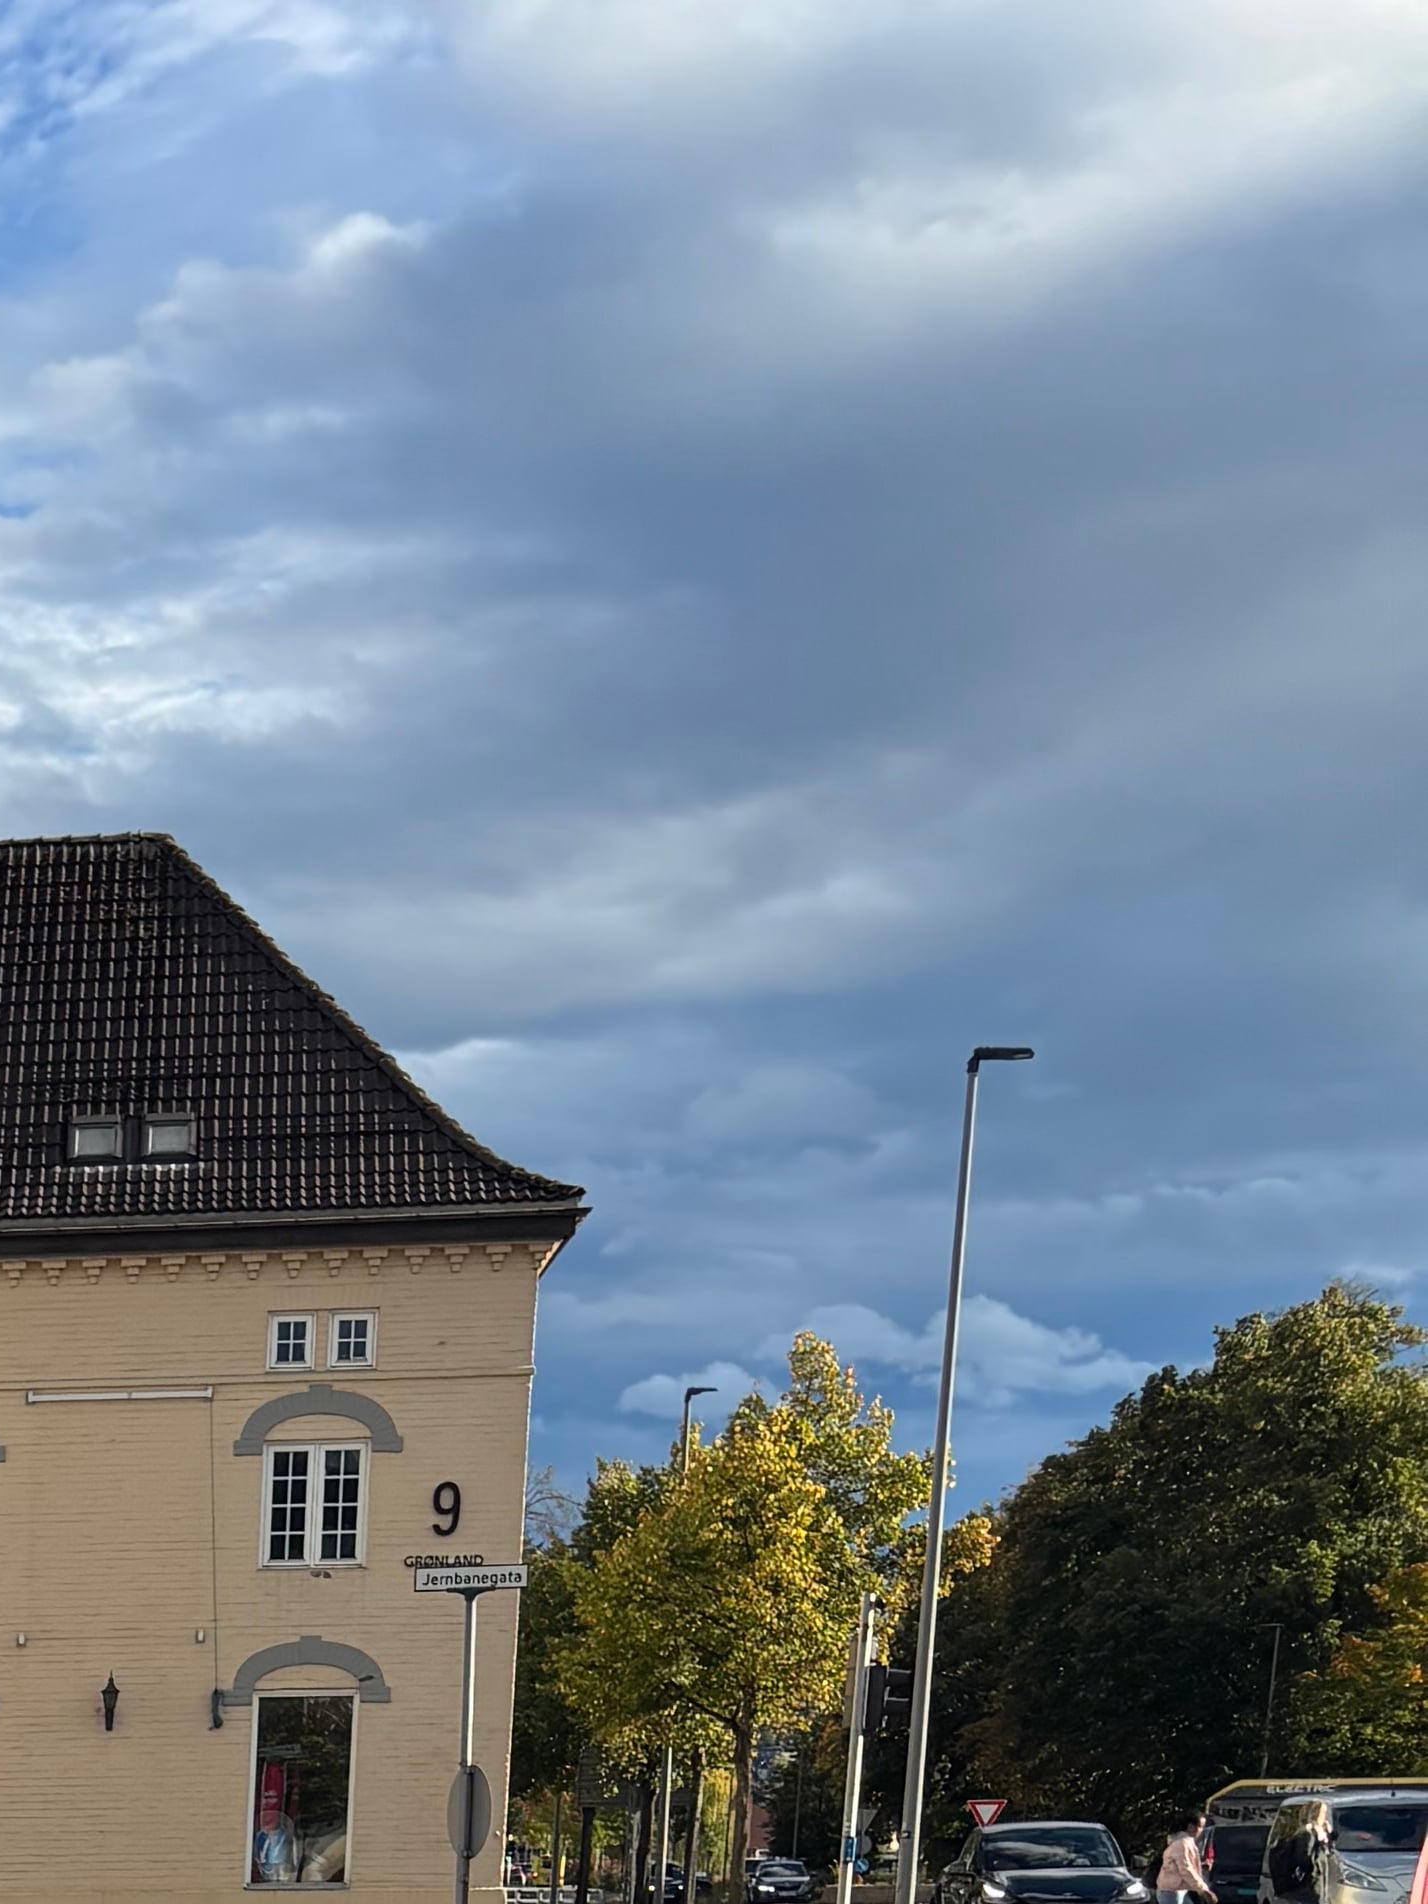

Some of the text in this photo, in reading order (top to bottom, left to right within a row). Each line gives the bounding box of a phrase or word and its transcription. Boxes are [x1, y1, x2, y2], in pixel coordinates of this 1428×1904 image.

[431, 1481, 461, 1537] 9
[403, 1554, 484, 1568] GRØNLAND
[422, 1571, 523, 1586] Jernbanegata
